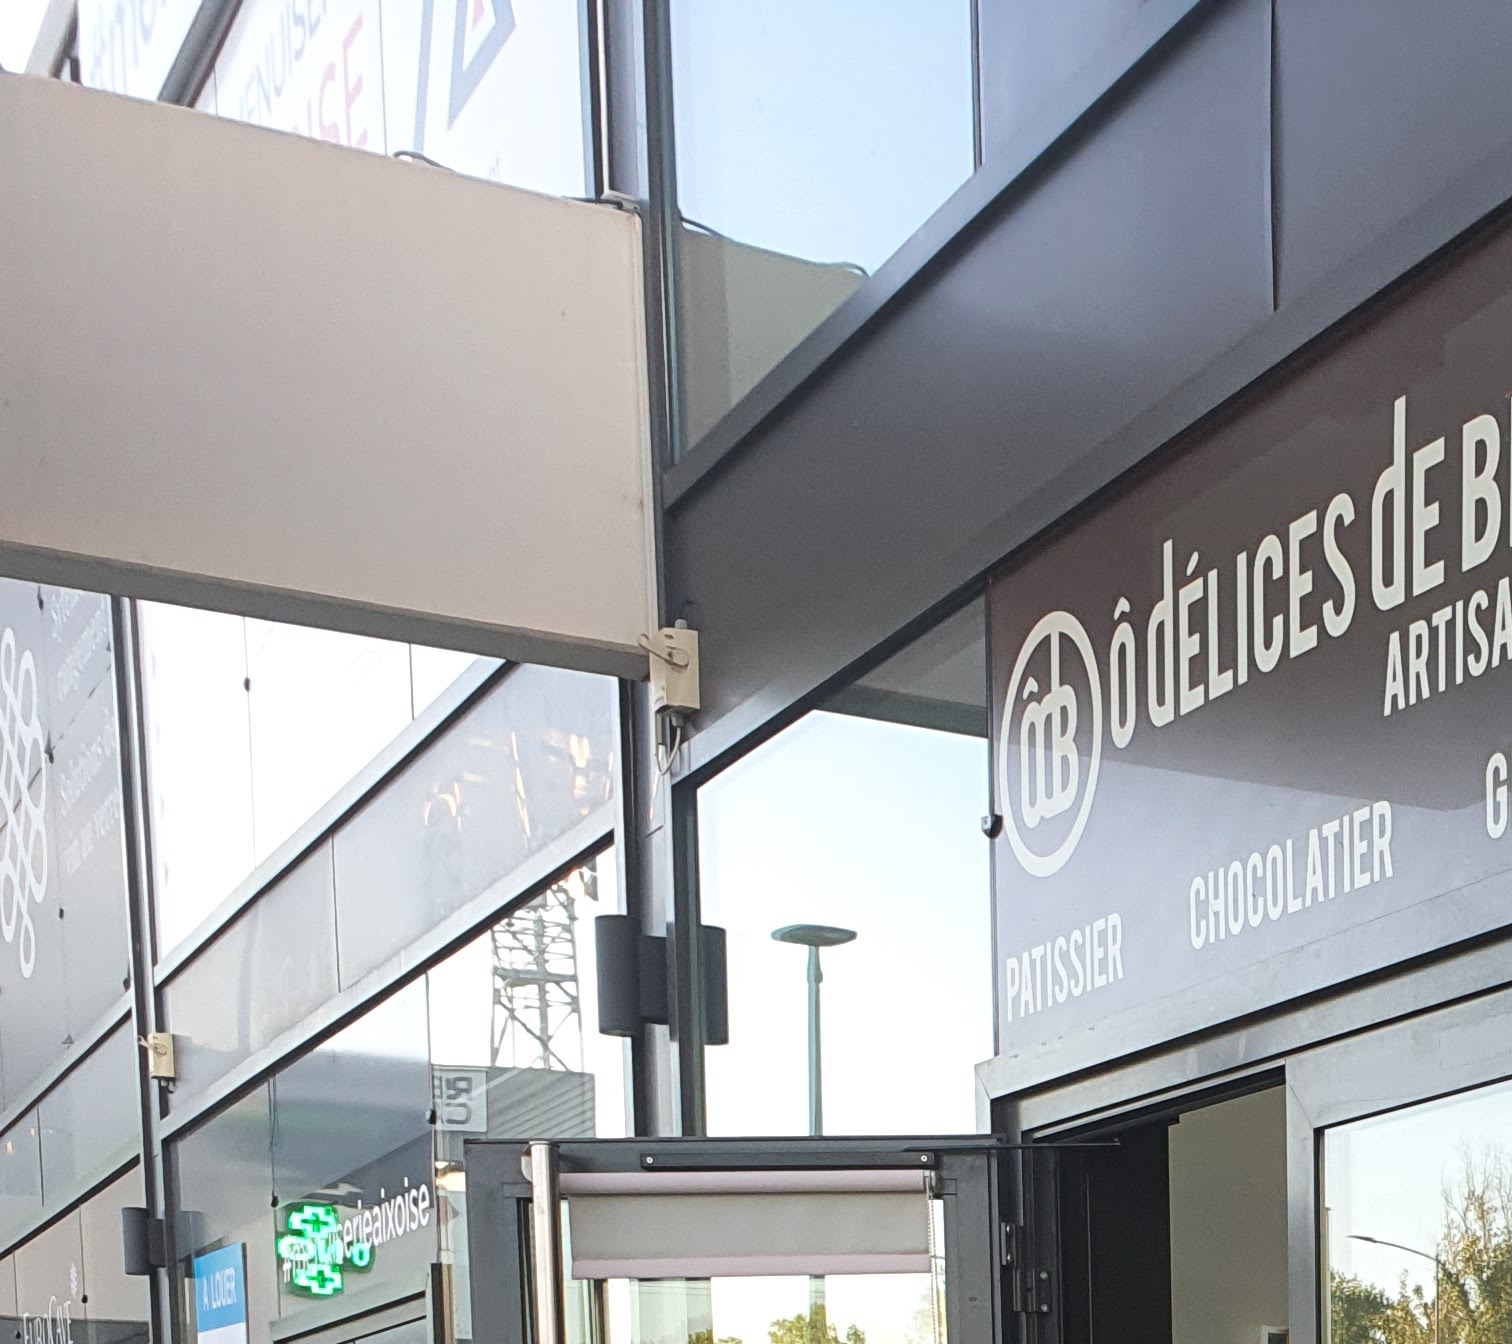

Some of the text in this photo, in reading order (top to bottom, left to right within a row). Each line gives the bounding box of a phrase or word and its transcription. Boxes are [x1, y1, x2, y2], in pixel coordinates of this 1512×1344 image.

[1189, 801, 1394, 951] CHOCOLATIER
[1006, 913, 1124, 1022] PATISSIER
[211, 1267, 237, 1309] LOUER
